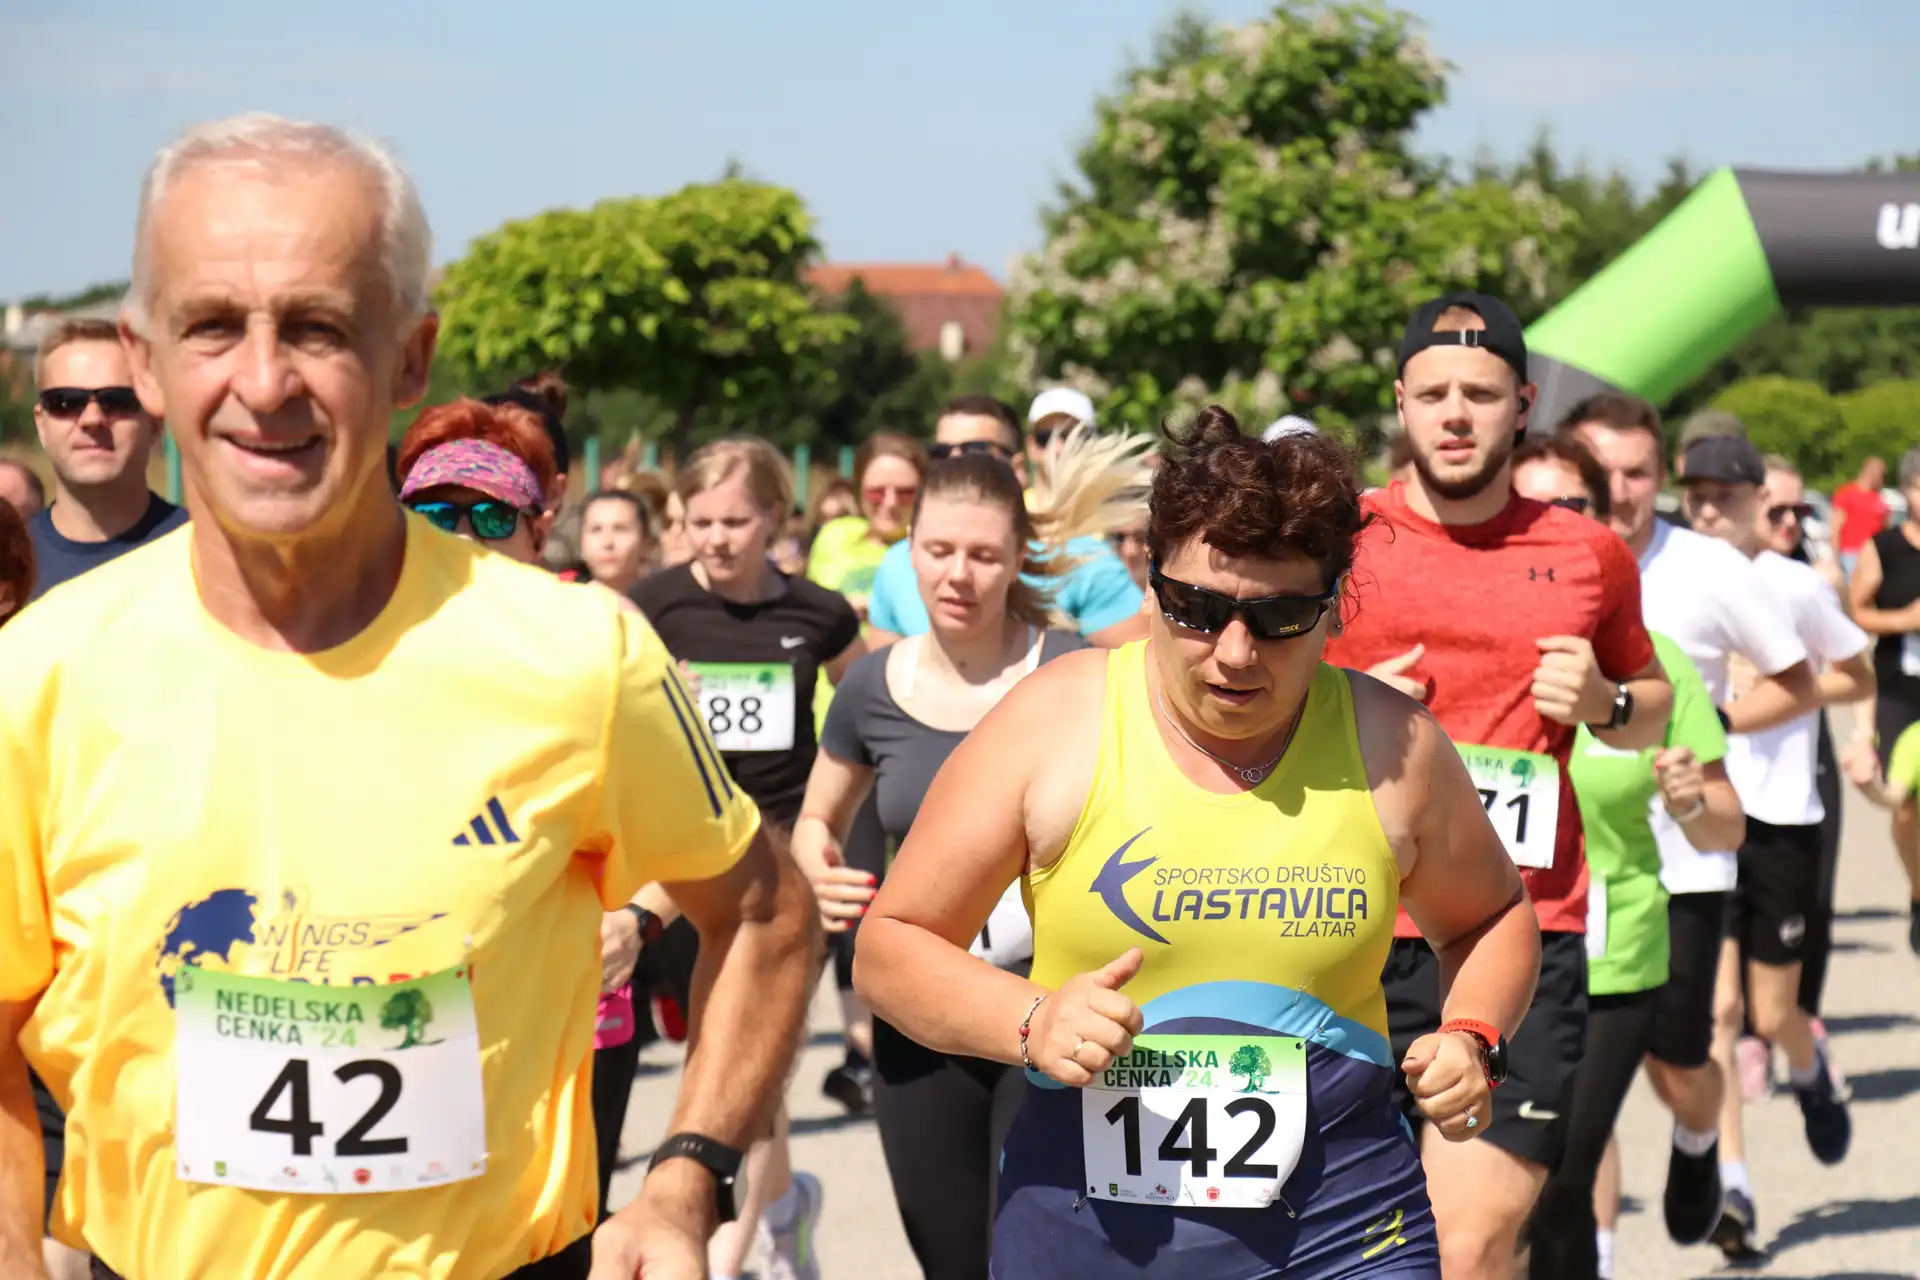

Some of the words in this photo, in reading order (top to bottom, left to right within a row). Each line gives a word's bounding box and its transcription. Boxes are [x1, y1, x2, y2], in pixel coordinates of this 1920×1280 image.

[709, 697, 762, 733] 88
[1154, 867, 1270, 886] SPORTSKO
[1276, 863, 1366, 885] DRUŠTVO
[1152, 887, 1368, 922] LASTAVICA
[260, 913, 371, 948] WINGS
[1280, 921, 1356, 938] ZLATAR
[270, 948, 338, 974] LIFE
[216, 989, 365, 1024] NEDELSKA
[216, 1014, 303, 1046] CENKA
[1104, 1069, 1173, 1088] CENKA
[250, 1059, 409, 1158] 42
[1104, 1096, 1279, 1179] 142
